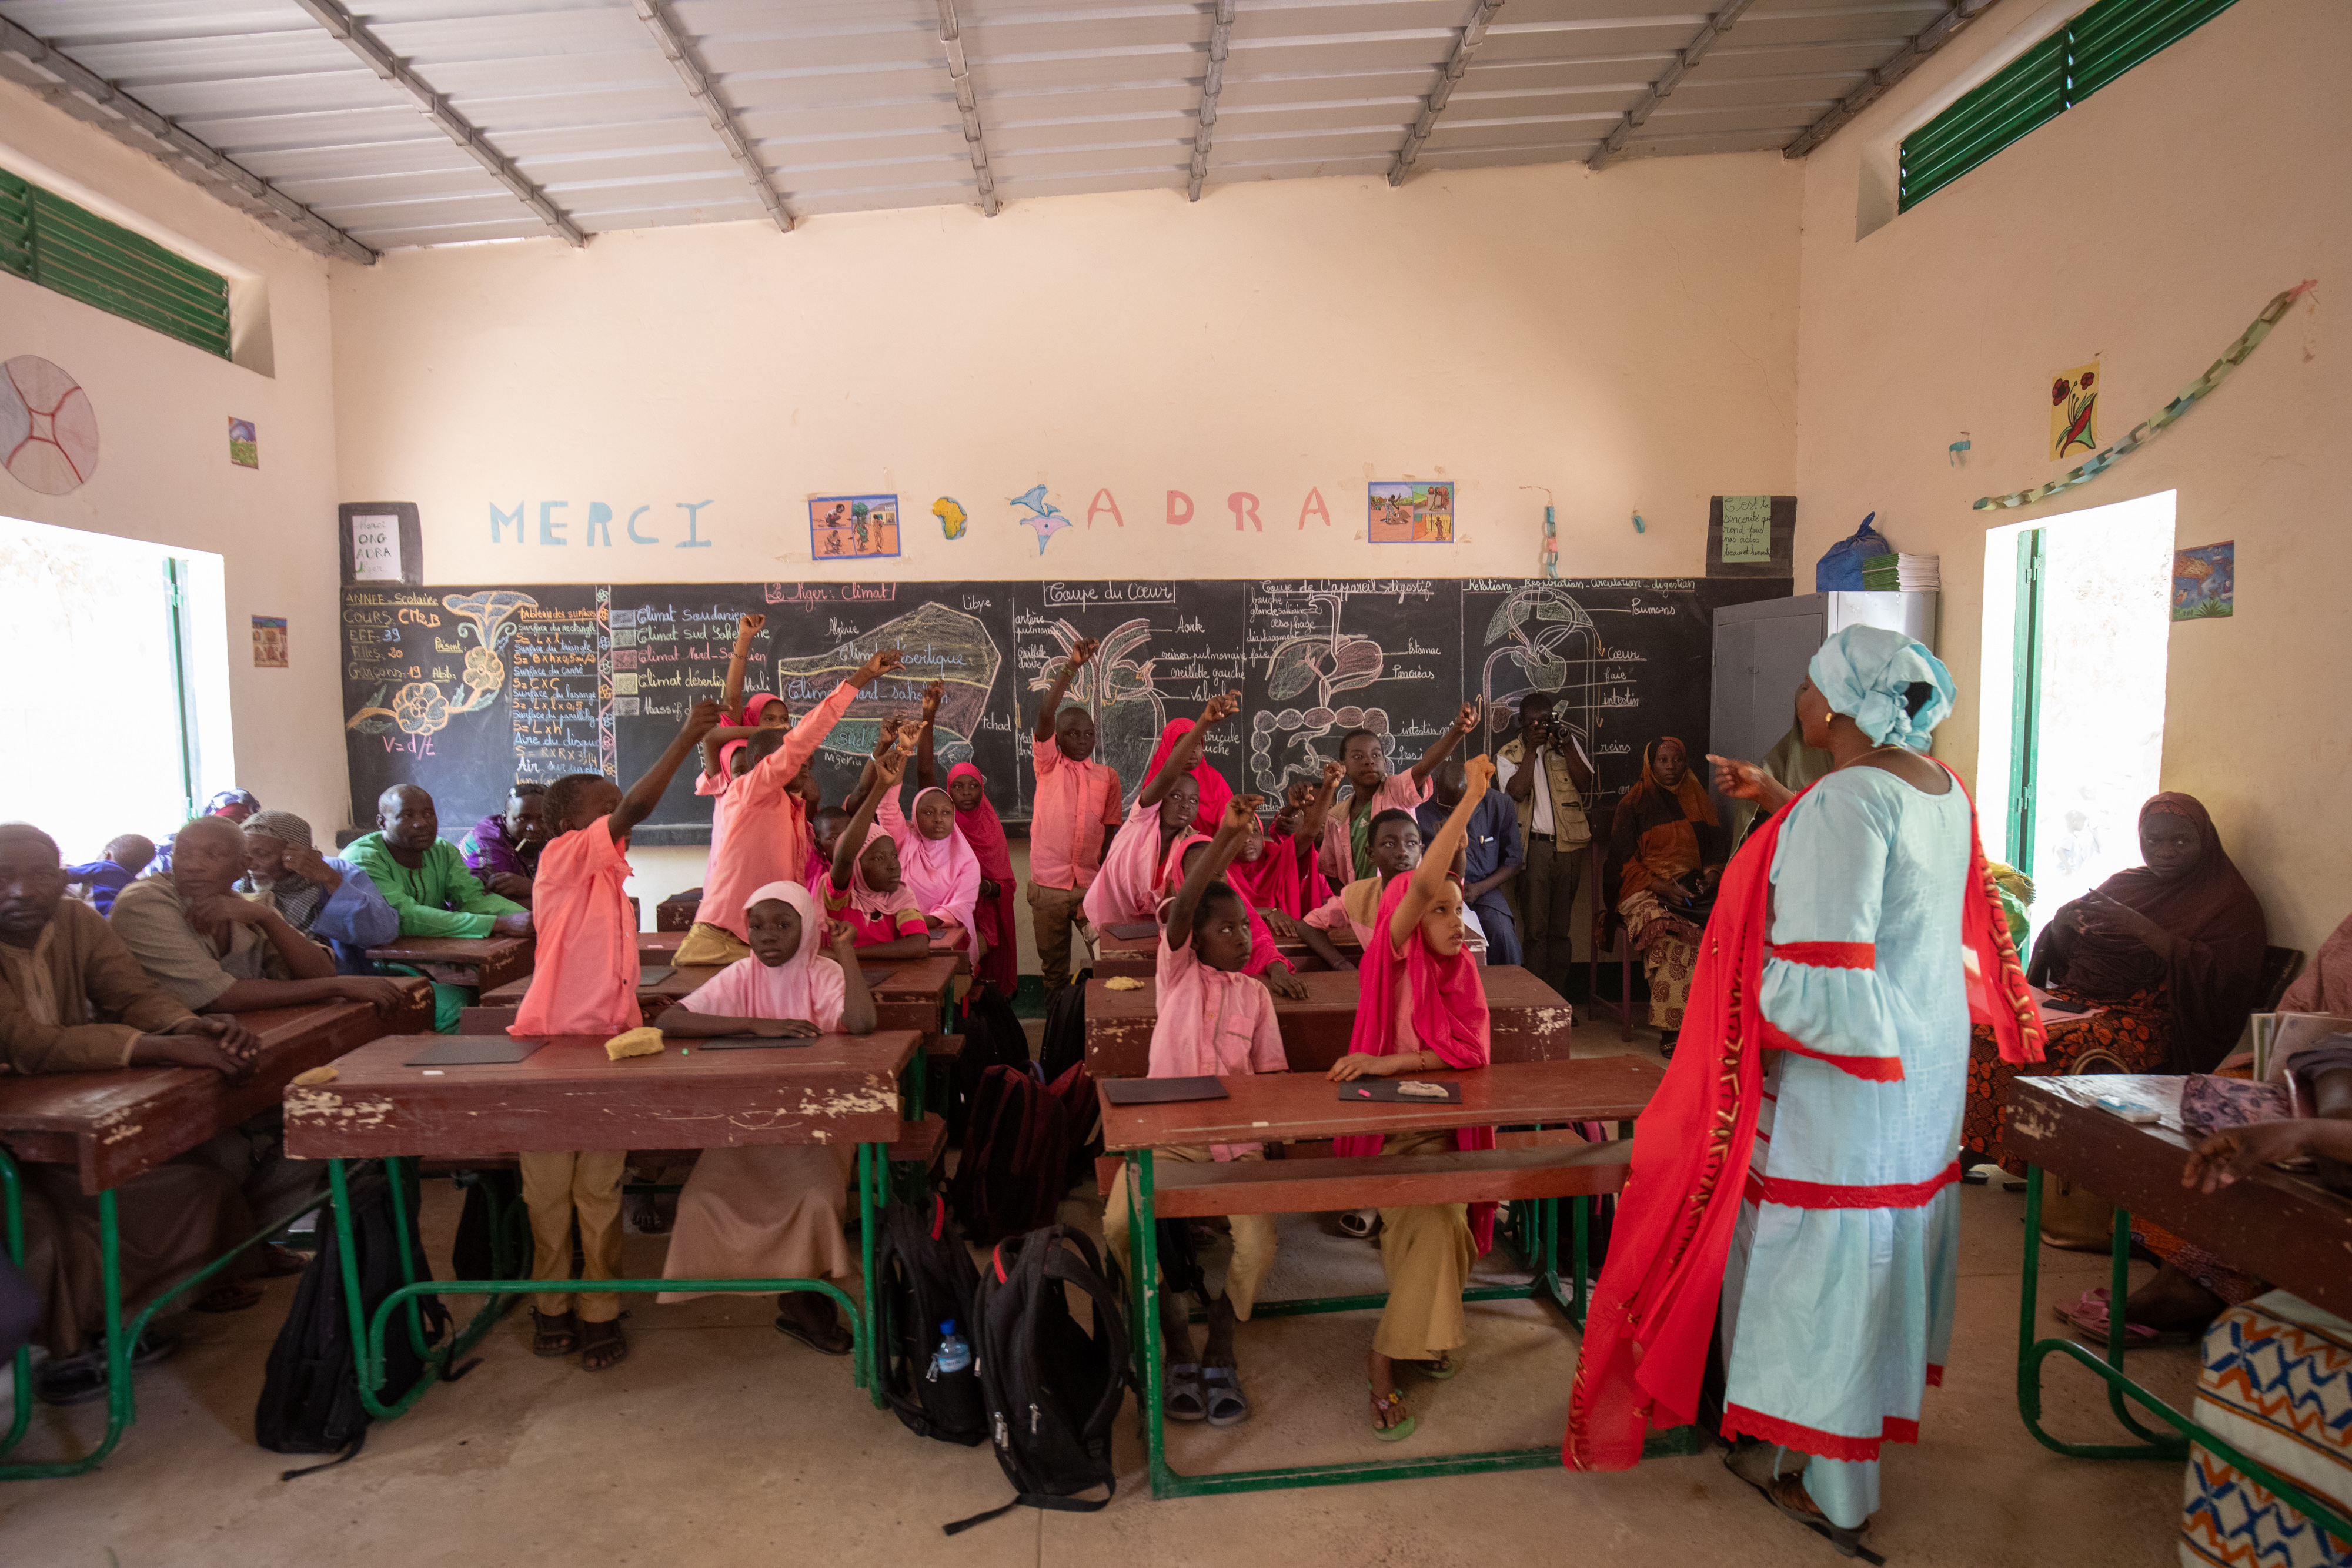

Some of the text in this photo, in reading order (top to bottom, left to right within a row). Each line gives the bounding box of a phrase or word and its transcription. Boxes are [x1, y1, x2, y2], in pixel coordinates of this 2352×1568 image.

[1760, 495, 1770, 509] la
[489, 486, 1331, 548] MERCI ADRA
[1723, 511, 1759, 524] sincérité
[1723, 523, 1764, 534] rend tous
[359, 533, 387, 544] ONG
[1740, 533, 1760, 543] actes
[356, 547, 392, 559] ADRA
[346, 593, 385, 604] ANNEE
[841, 582, 890, 601] Climat
[1046, 582, 1098, 613] Coupe
[1104, 581, 1122, 600] du
[1250, 587, 1283, 607] bouche
[1260, 580, 1292, 597] Coupe
[1299, 579, 1314, 593] de
[1383, 580, 1431, 604] digestif
[963, 594, 991, 614] Libye
[1632, 598, 1676, 616] Poumons
[636, 604, 677, 624] Climat
[1015, 607, 1045, 624] artère
[1250, 604, 1278, 623] glande
[518, 623, 547, 636] Surface
[549, 622, 560, 632] du
[827, 617, 859, 643] Algérie
[1175, 614, 1205, 633] Aorte
[382, 627, 401, 643] 39
[637, 624, 679, 644] Climat
[514, 643, 543, 657] Surface
[546, 642, 557, 653] du
[638, 645, 679, 664] Climat
[1162, 643, 1248, 665] veines pulmonaire
[1408, 637, 1441, 656] Estomac
[513, 666, 546, 680] Surface
[548, 664, 559, 674] du
[1018, 657, 1042, 669] droite
[638, 668, 681, 688] Climat
[741, 670, 770, 693] Mali
[1213, 660, 1245, 686] gauche
[1394, 665, 1435, 680] Pancréas
[513, 688, 548, 703] Surface
[553, 687, 564, 698] du
[1603, 687, 1639, 707] intestin
[513, 708, 544, 726] Surface
[545, 708, 556, 719] du
[983, 711, 1011, 731] tchad
[1398, 718, 1436, 735] intestin
[543, 733, 559, 746] du
[1600, 740, 1631, 752] reins
